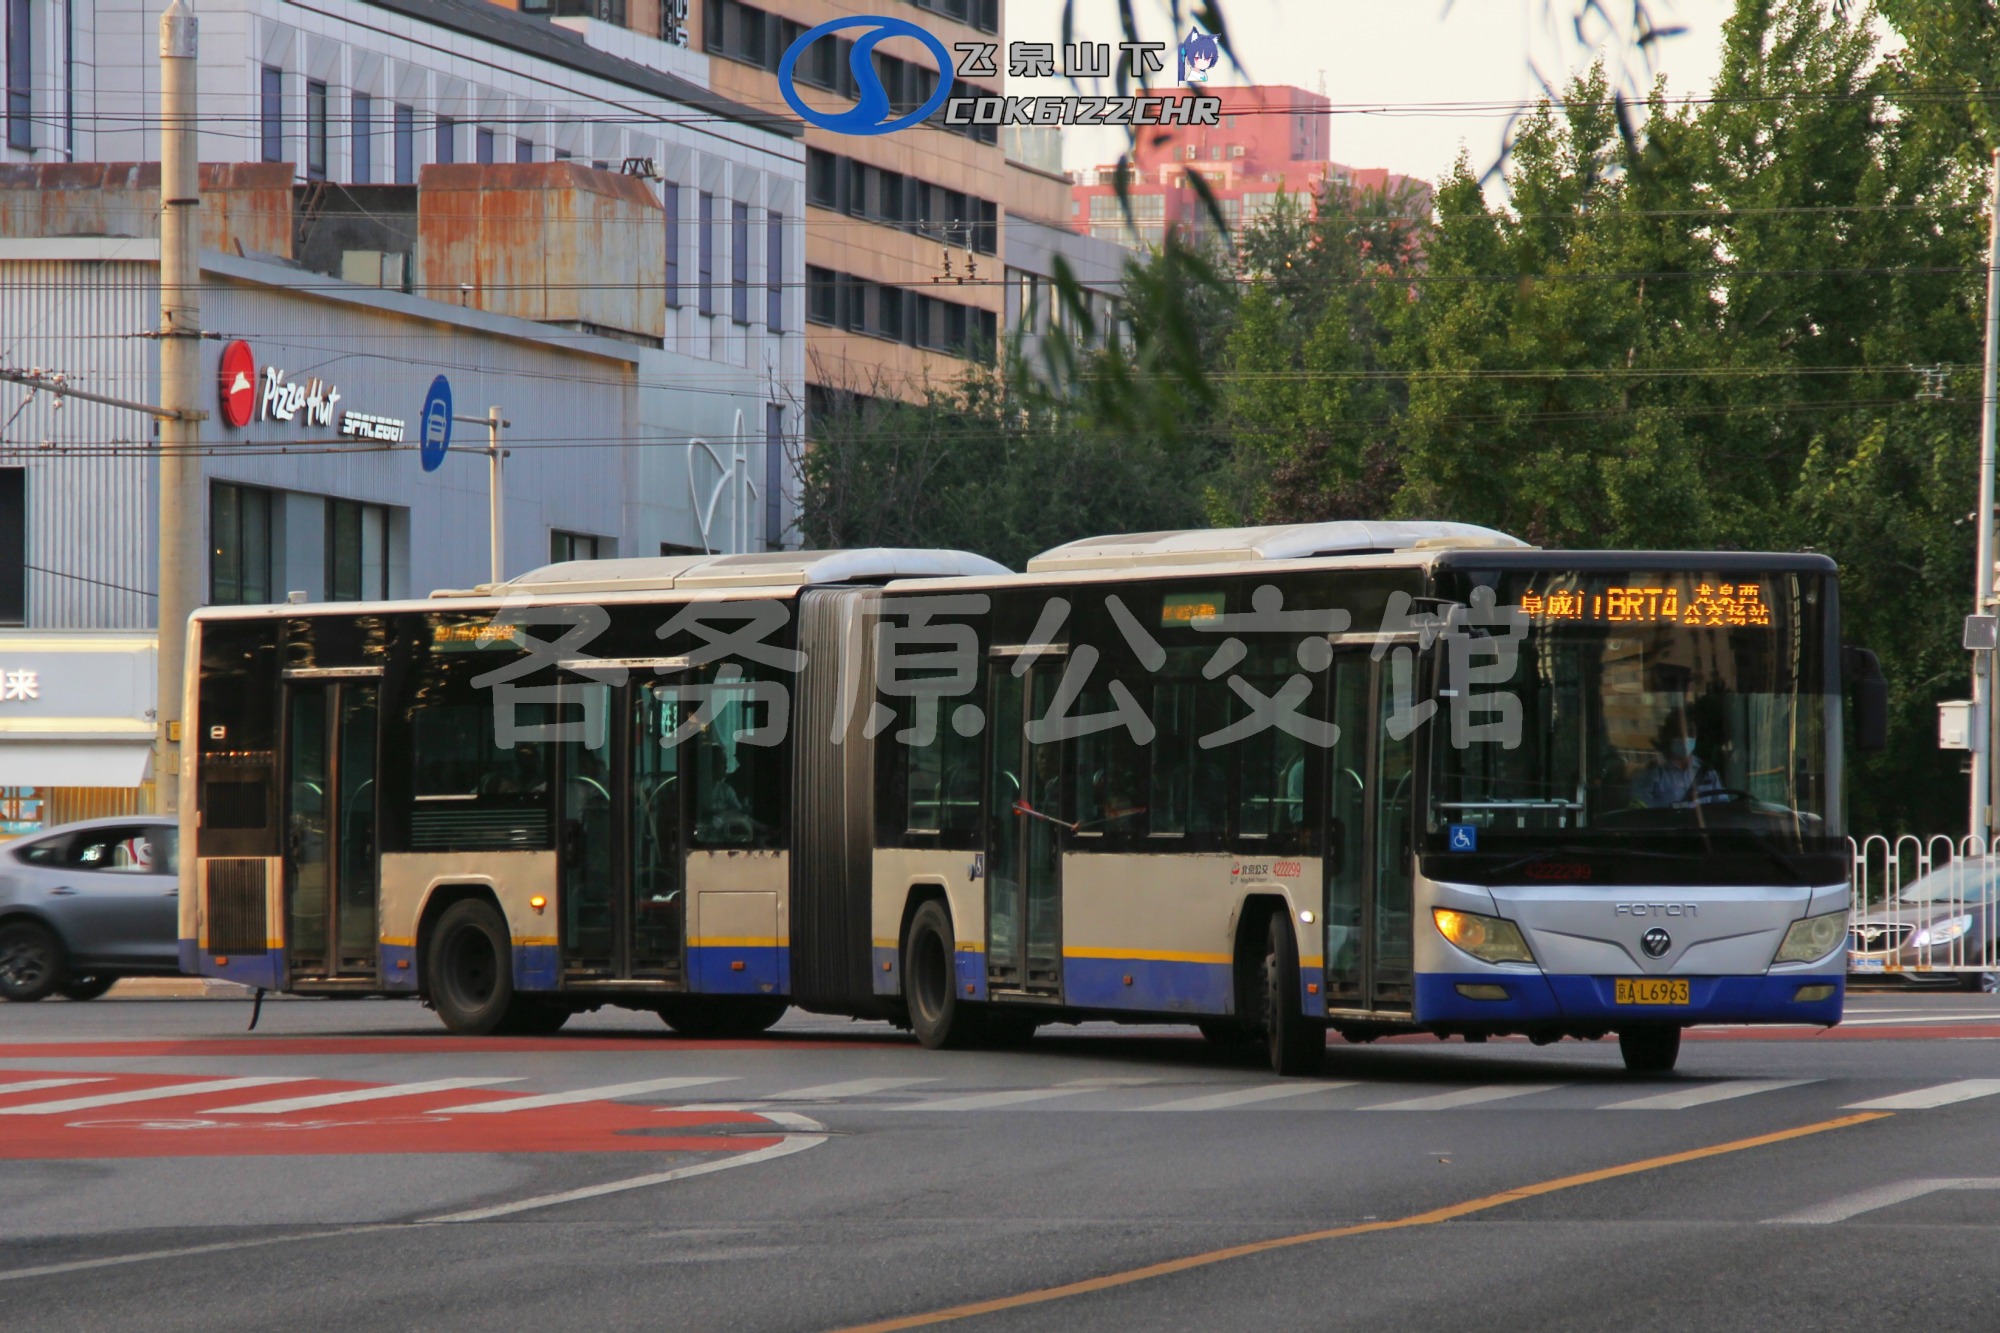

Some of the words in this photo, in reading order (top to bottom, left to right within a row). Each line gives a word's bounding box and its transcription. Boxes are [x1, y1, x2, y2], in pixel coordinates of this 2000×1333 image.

[261, 366, 306, 421] Pizza
[306, 377, 341, 427] Hut
[1608, 588, 1678, 621] BRT4
[0, 668, 39, 701] 来
[1241, 864, 1269, 875] 北京公交
[1615, 902, 1699, 918] FOTON
